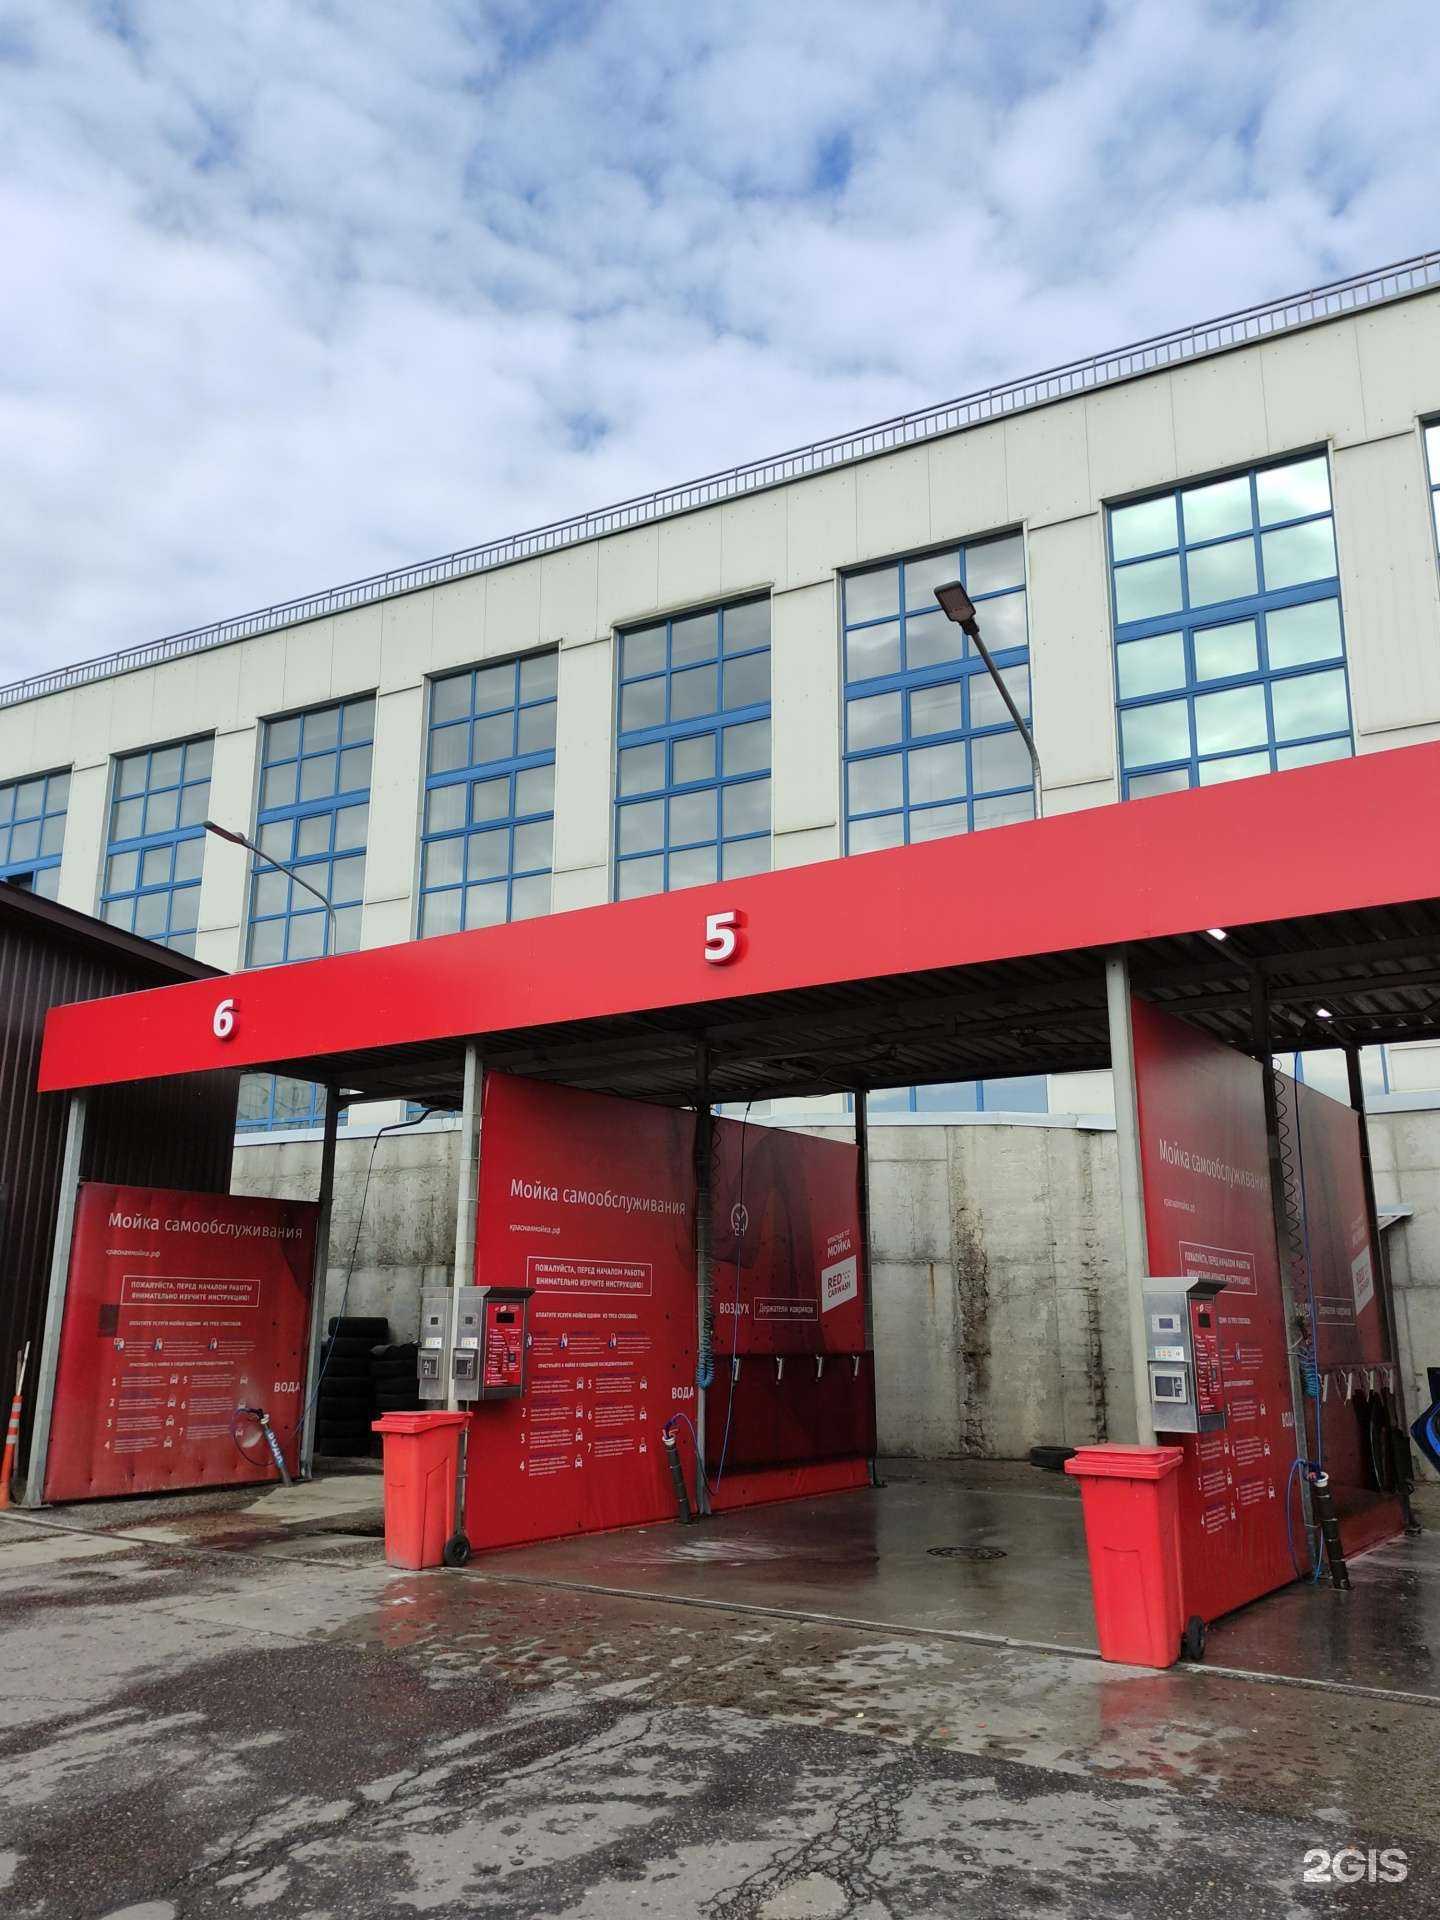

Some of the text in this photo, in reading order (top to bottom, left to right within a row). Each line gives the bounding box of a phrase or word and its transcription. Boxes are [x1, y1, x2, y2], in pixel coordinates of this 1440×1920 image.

[704, 910, 742, 963] 5
[212, 998, 237, 1039] 6
[1159, 1138, 1190, 1169] Мойка
[510, 1178, 686, 1215] Мойка самообслуживания
[108, 1212, 302, 1239] Мойка самообслуживания
[827, 1238, 851, 1259] МОЙКА
[535, 1263, 645, 1277] ПОЖАЛУЙСТА, ПЕРЕД НАЧАЛОМ РАБОТЫ
[131, 1281, 175, 1290] ПОЖАЛУЙСТА,
[176, 1282, 197, 1290] ПЕРЕД
[199, 1283, 227, 1291] НАЧАЛОМ
[536, 1276, 579, 1286] ВНИМАТЕЛЬНО
[827, 1273, 843, 1290] RED
[719, 1302, 749, 1315] ВОЗДУХ
[112, 1378, 117, 1387] 1
[182, 1376, 188, 1385] 5
[587, 1379, 592, 1389] 5
[273, 1381, 301, 1394] ВОДА
[671, 1386, 695, 1400] ВОДА
[109, 1398, 115, 1407] 2
[181, 1401, 186, 1410] 6
[521, 1407, 527, 1418] 2
[587, 1411, 593, 1421] 6
[106, 1418, 112, 1428] 3
[178, 1427, 184, 1436] 7
[520, 1433, 526, 1444] 3
[104, 1441, 110, 1449] 4
[587, 1443, 592, 1453] 7
[519, 1460, 525, 1471] 4
